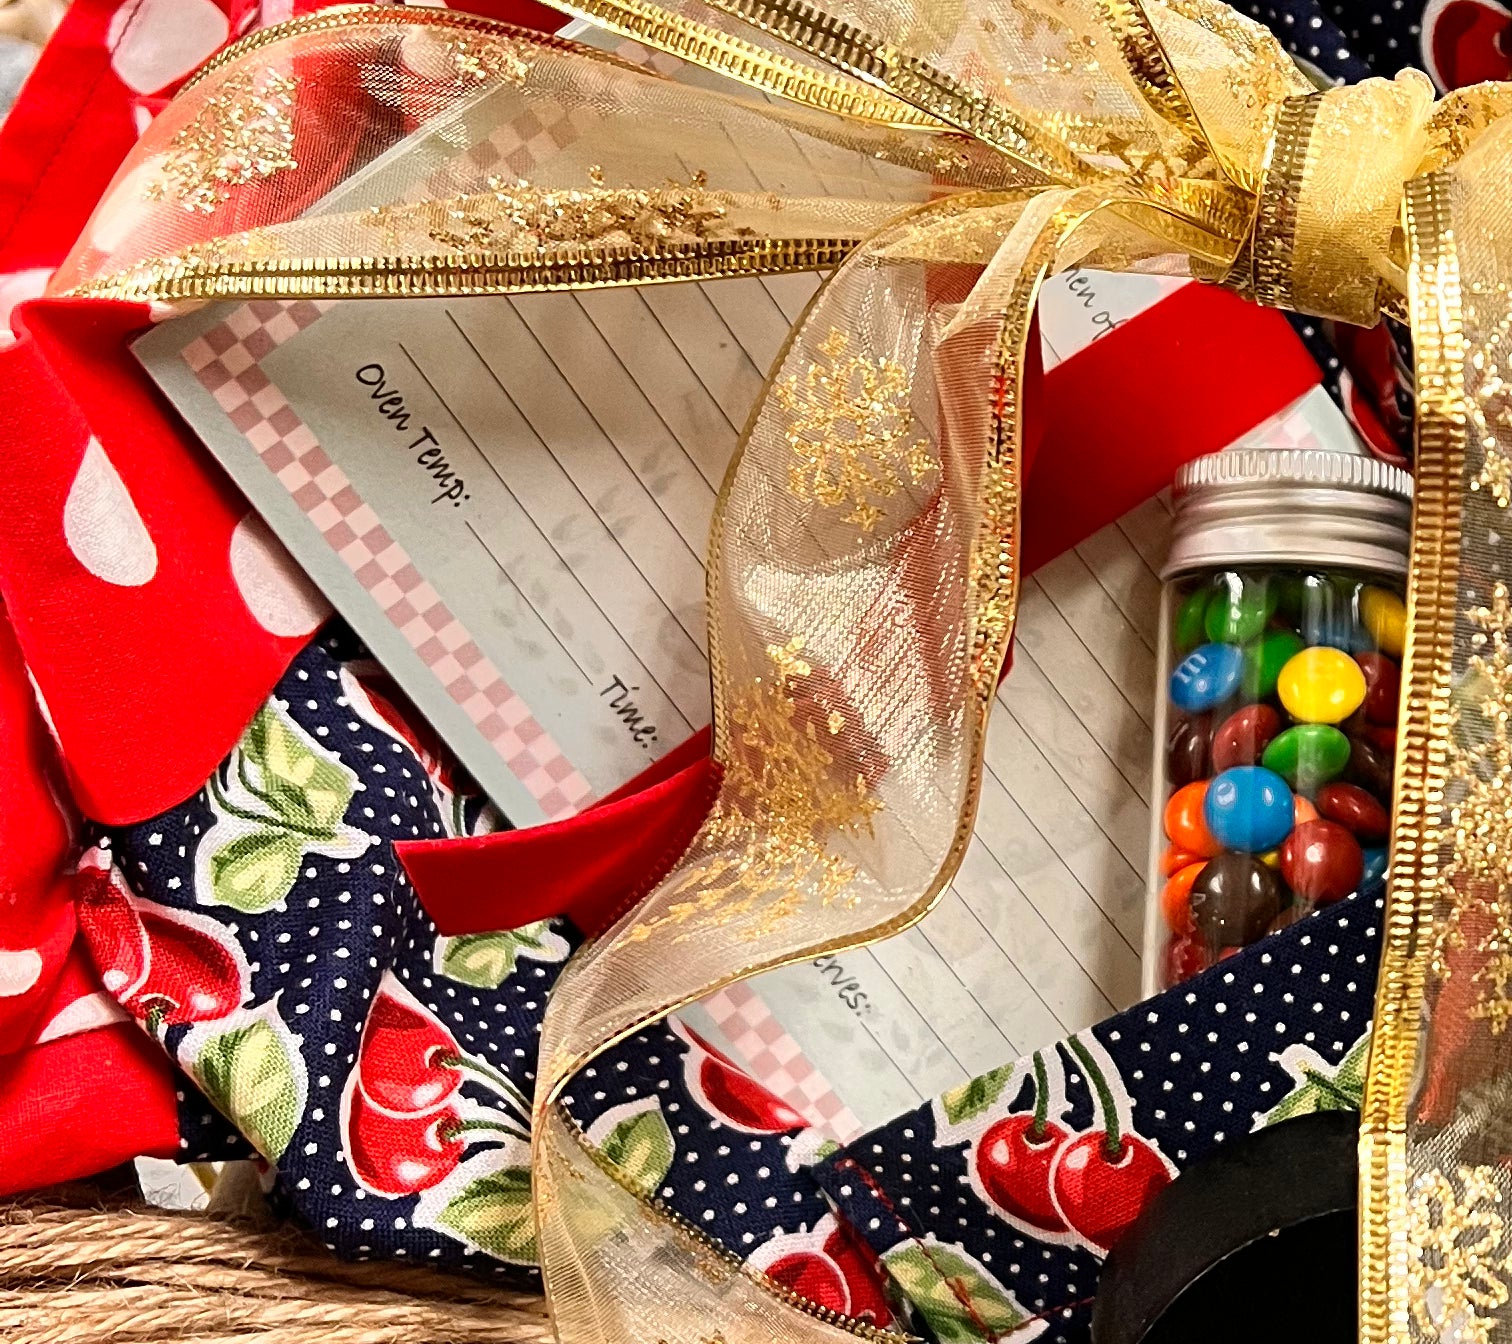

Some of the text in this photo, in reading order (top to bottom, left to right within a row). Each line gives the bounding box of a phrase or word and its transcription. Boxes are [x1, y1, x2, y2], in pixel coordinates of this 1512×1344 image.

[355, 363, 471, 508] Oven Temp:
[599, 673, 658, 749] Time:
[812, 954, 872, 1017] erves:
